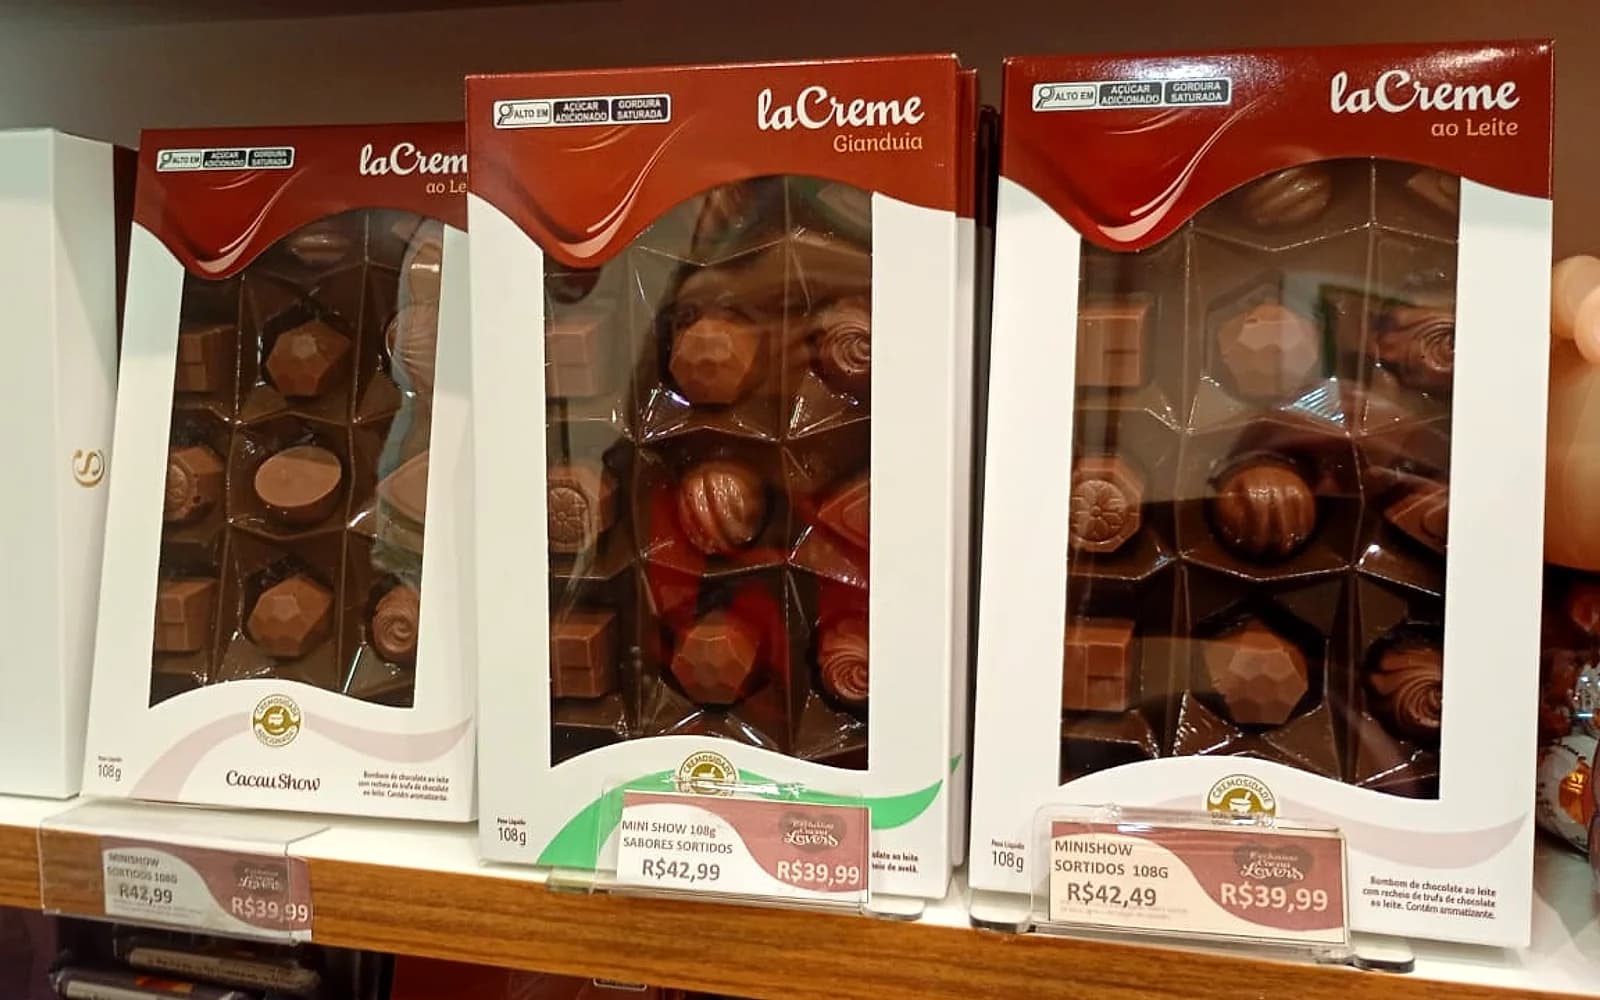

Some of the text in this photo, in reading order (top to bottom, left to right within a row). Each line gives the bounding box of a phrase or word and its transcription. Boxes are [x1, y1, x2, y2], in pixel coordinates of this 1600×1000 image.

[1055, 91, 1094, 101] ALTO EM
[1173, 81, 1221, 92] GORDURA
[1331, 69, 1520, 113] laCreme
[618, 99, 661, 110] GORDURA
[1101, 95, 1159, 105] ADICIONADO
[1171, 92, 1222, 103] SATURADA
[514, 108, 548, 118] ALTO EM
[555, 111, 608, 122] ADICIONADO
[616, 109, 663, 120] SATURADA
[757, 85, 925, 130] laCreme
[1431, 117, 1519, 136] ao Leite
[833, 132, 923, 152] Gianduia
[359, 142, 467, 175] laCrem
[426, 180, 467, 193] ao Le
[498, 827, 526, 846] 108g
[621, 820, 717, 839] MINI SHOW 108g
[623, 836, 733, 854] SABORES SORTIDOS
[1055, 839, 1133, 857] MINISHOW
[642, 857, 721, 883] R$42,99
[992, 850, 1024, 873] 108g
[1055, 858, 1169, 879] SORTIDOS 108G
[777, 860, 860, 887] R$39,99
[119, 883, 174, 905] R42,99
[1067, 881, 1157, 908] R$42,49
[1220, 880, 1329, 913] R$39,99
[1421, 881, 1463, 894] chocolate
[1477, 885, 1497, 897] leite
[231, 895, 308, 923] R$39,99
[1456, 896, 1496, 908] chocolate
